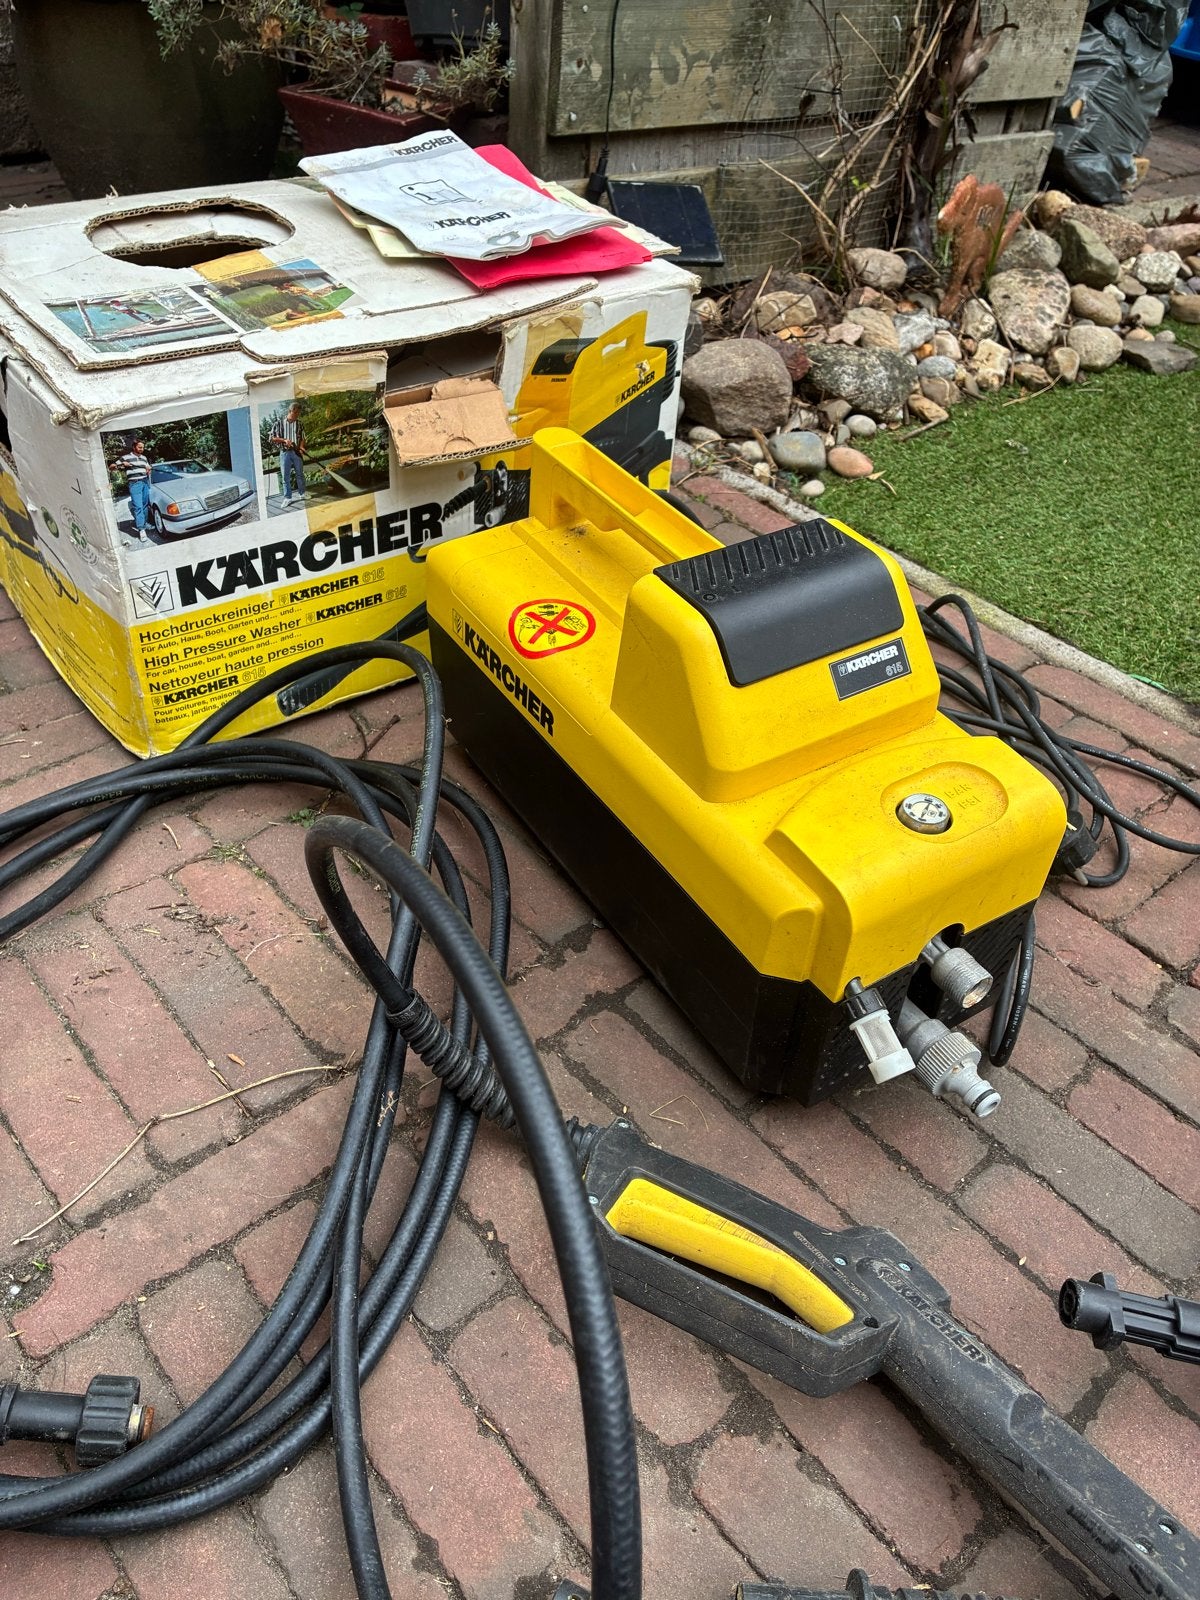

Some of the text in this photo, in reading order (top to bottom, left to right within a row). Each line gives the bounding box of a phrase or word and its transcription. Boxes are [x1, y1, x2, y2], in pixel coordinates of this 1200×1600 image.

[175, 502, 443, 607] KÄRCHER
[139, 567, 385, 643] Hochdruckreiniger KÄRCHER 615
[141, 646, 155, 654] Für
[157, 641, 179, 651] Auto,
[181, 634, 204, 644] Haus,
[205, 628, 227, 637] Boot,
[228, 619, 254, 630] Garten
[144, 585, 408, 671] High Pressure Washer KÄRCHER 615
[146, 671, 160, 679] For
[162, 668, 178, 676] car,
[179, 660, 205, 671] house,
[206, 653, 227, 663] boat,
[228, 645, 254, 658] garden
[149, 637, 324, 693] Nettoyeur haute pression
[464, 621, 555, 737] KÄRCHER
[886, 661, 904, 677] 615
[163, 666, 267, 705] KÄRCHER 615
[154, 708, 173, 717] Pour
[175, 699, 209, 713] voitures,
[155, 713, 190, 724] bateaux,
[191, 704, 220, 717] jardins,
[944, 784, 972, 799] BAR
